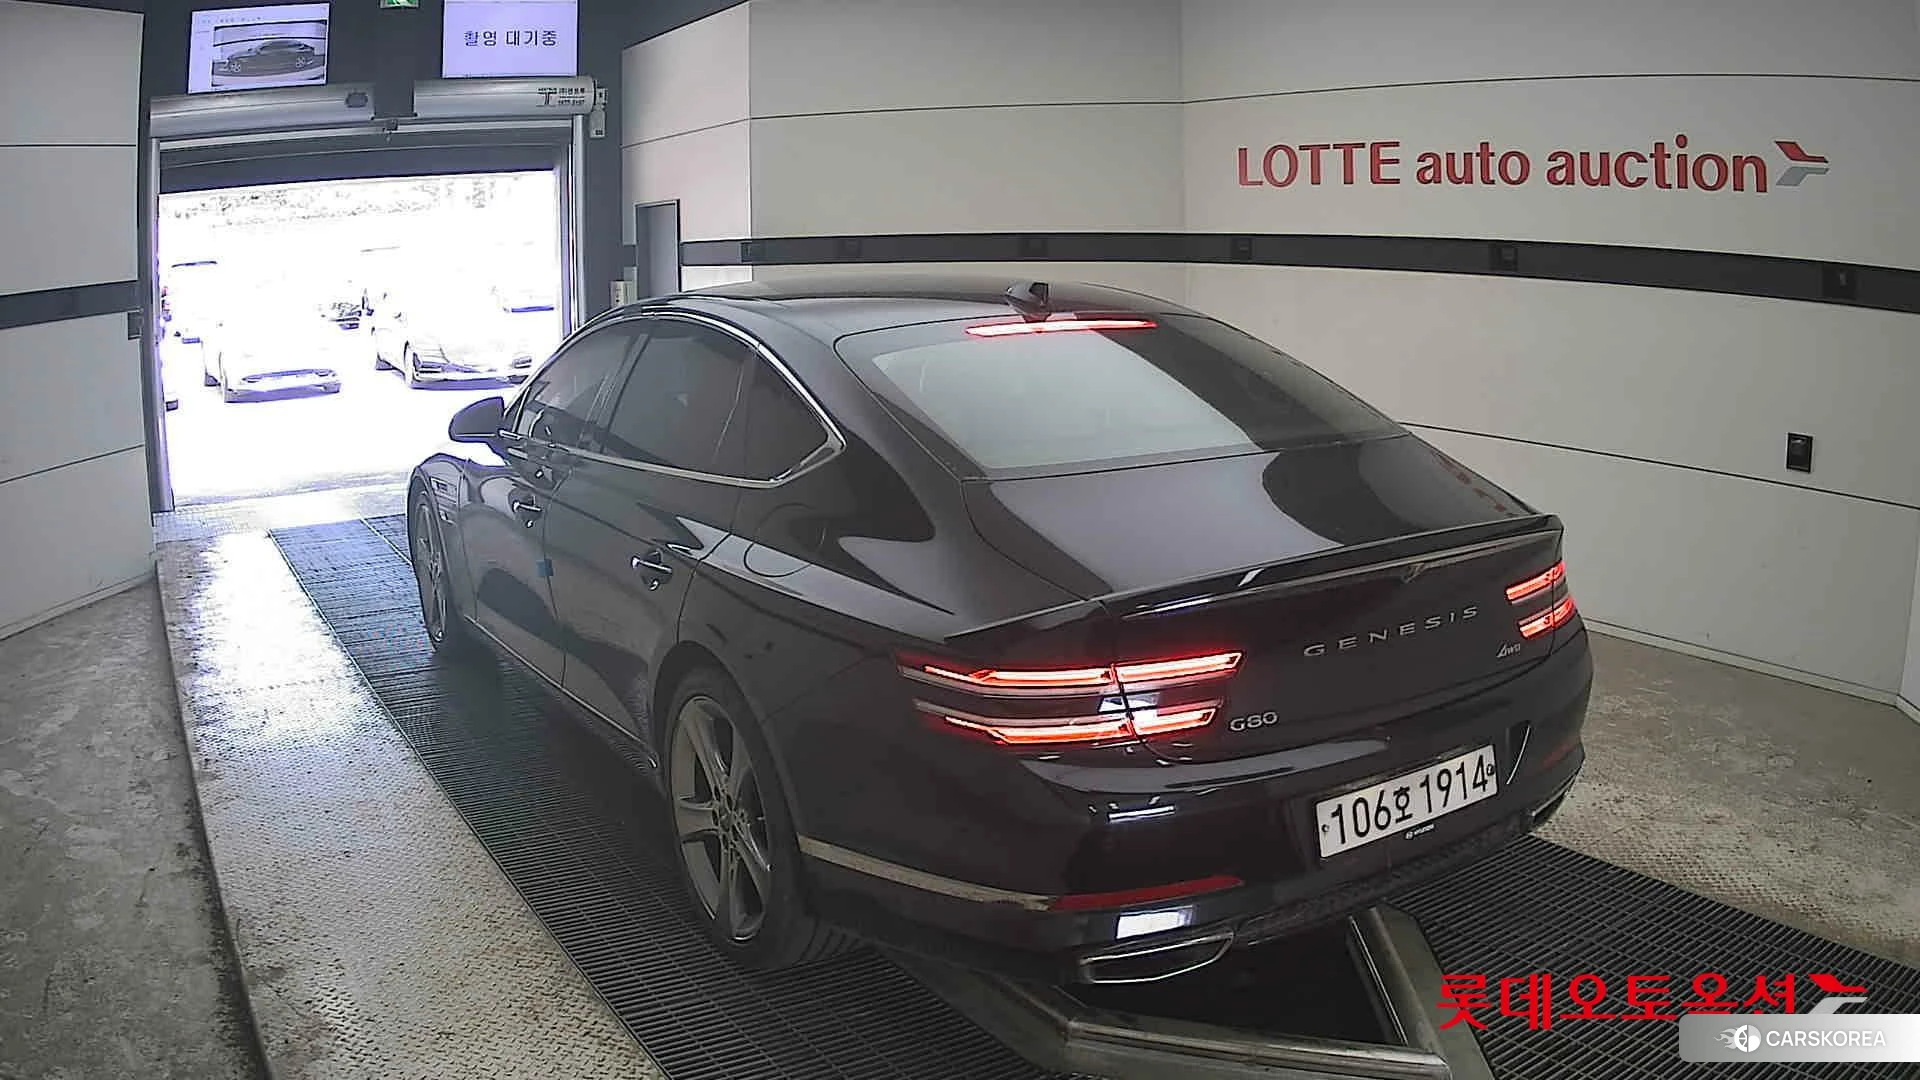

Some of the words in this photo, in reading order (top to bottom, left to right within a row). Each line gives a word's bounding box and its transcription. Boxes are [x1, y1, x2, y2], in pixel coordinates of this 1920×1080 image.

[505, 29, 558, 46] 대기중
[1238, 141, 1401, 188] LOTTE
[1416, 141, 1531, 186] auto
[1546, 134, 1769, 193] auction
[1303, 606, 1478, 657] GENESIS
[1230, 711, 1278, 731] G80
